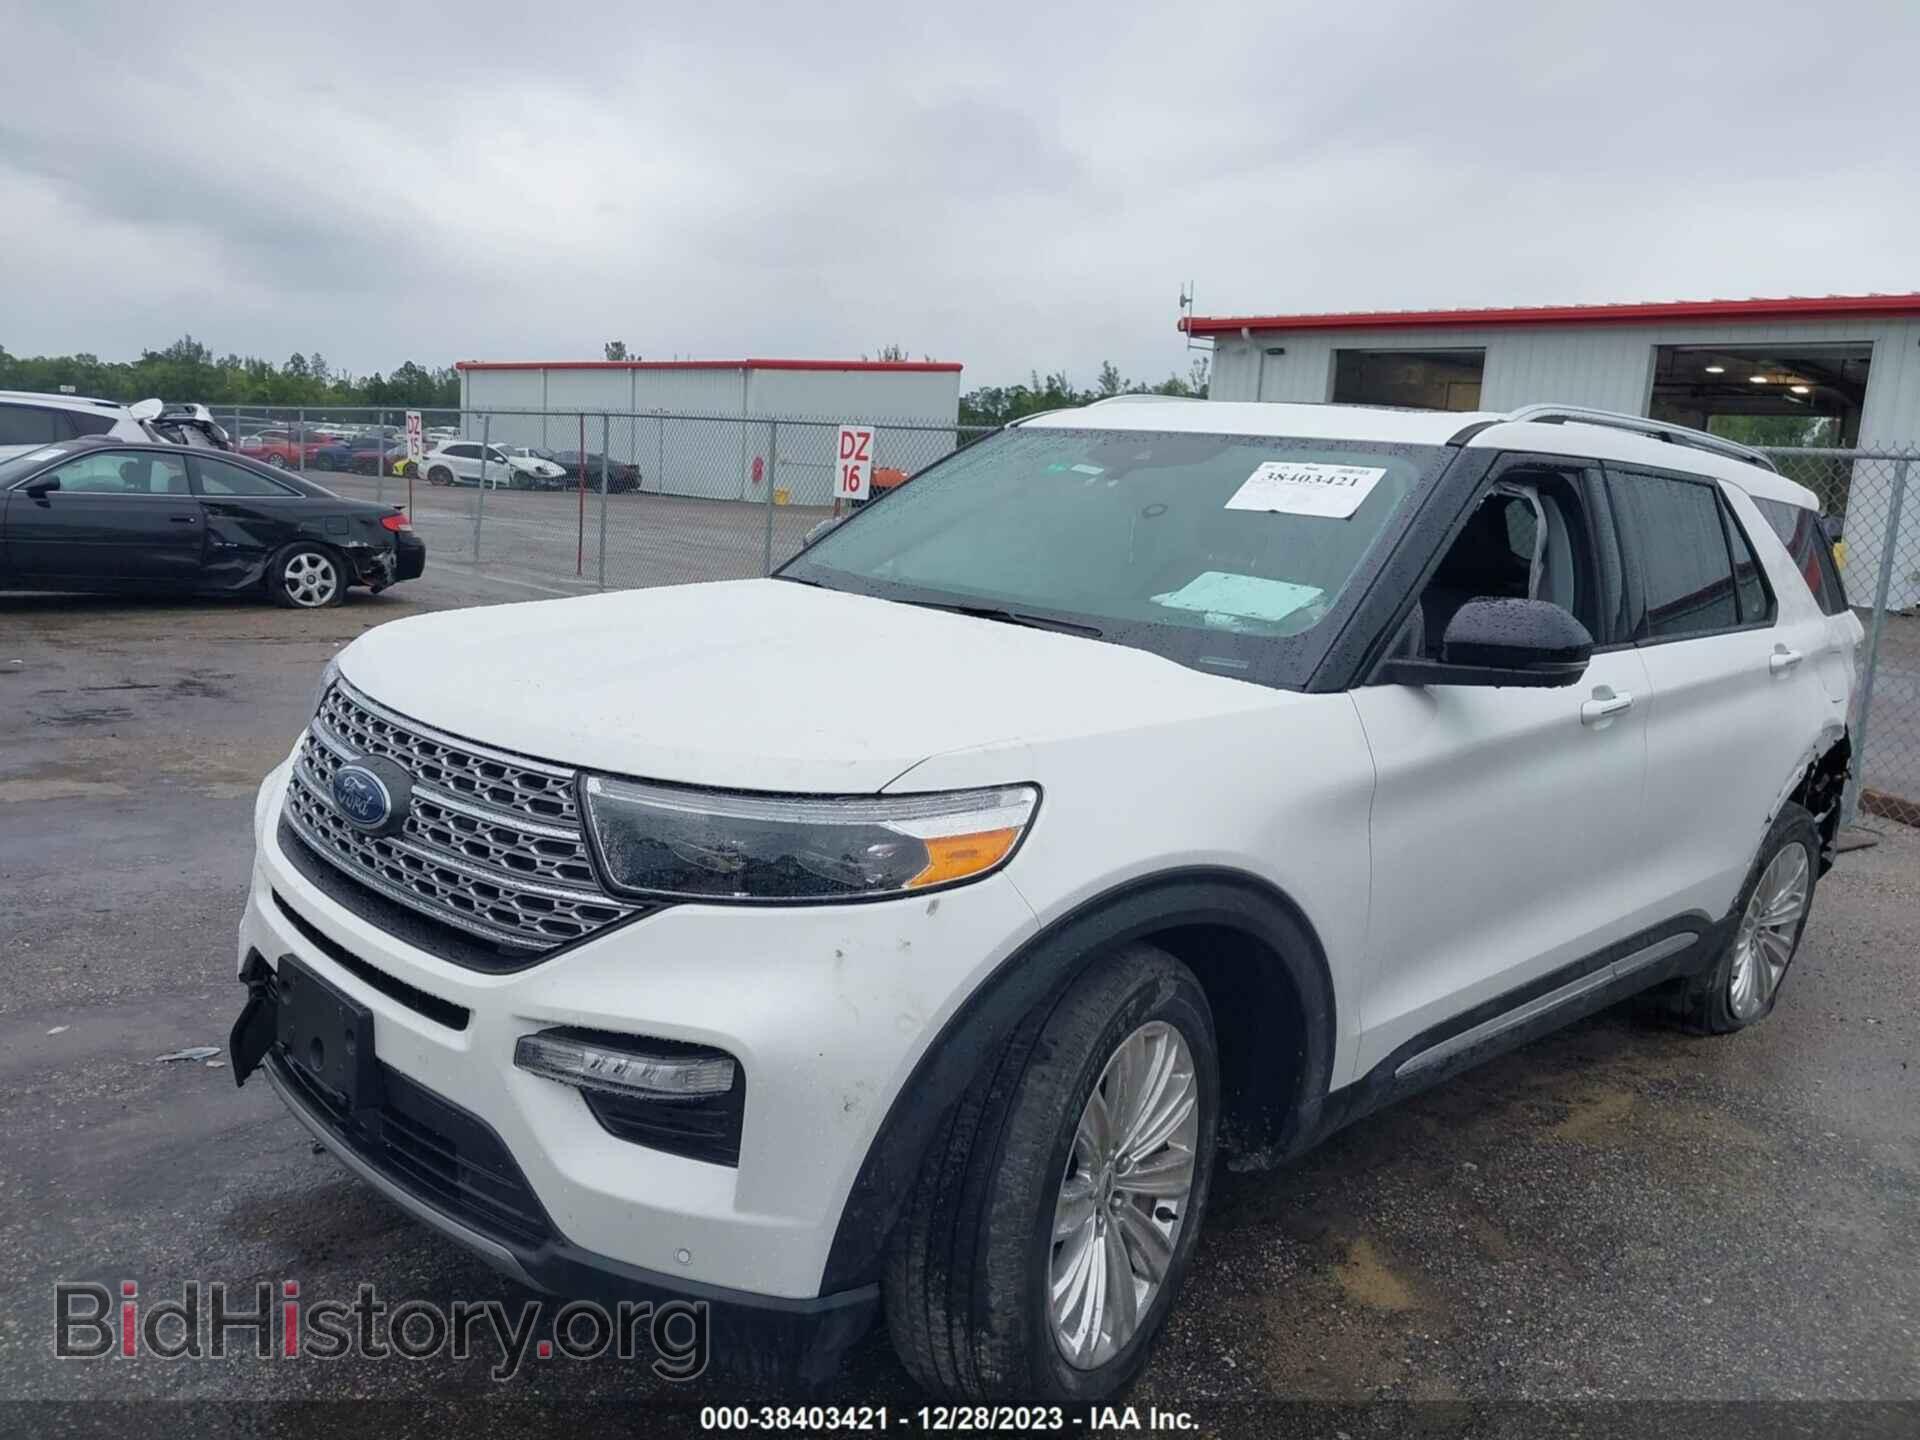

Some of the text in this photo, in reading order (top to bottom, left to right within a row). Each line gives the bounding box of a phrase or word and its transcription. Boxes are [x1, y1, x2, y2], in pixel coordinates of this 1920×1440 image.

[408, 415, 420, 434] DZ
[840, 431, 870, 461] DZ
[842, 464, 861, 492] 16
[1262, 472, 1359, 488] 38403421
[339, 776, 374, 817] Ford
